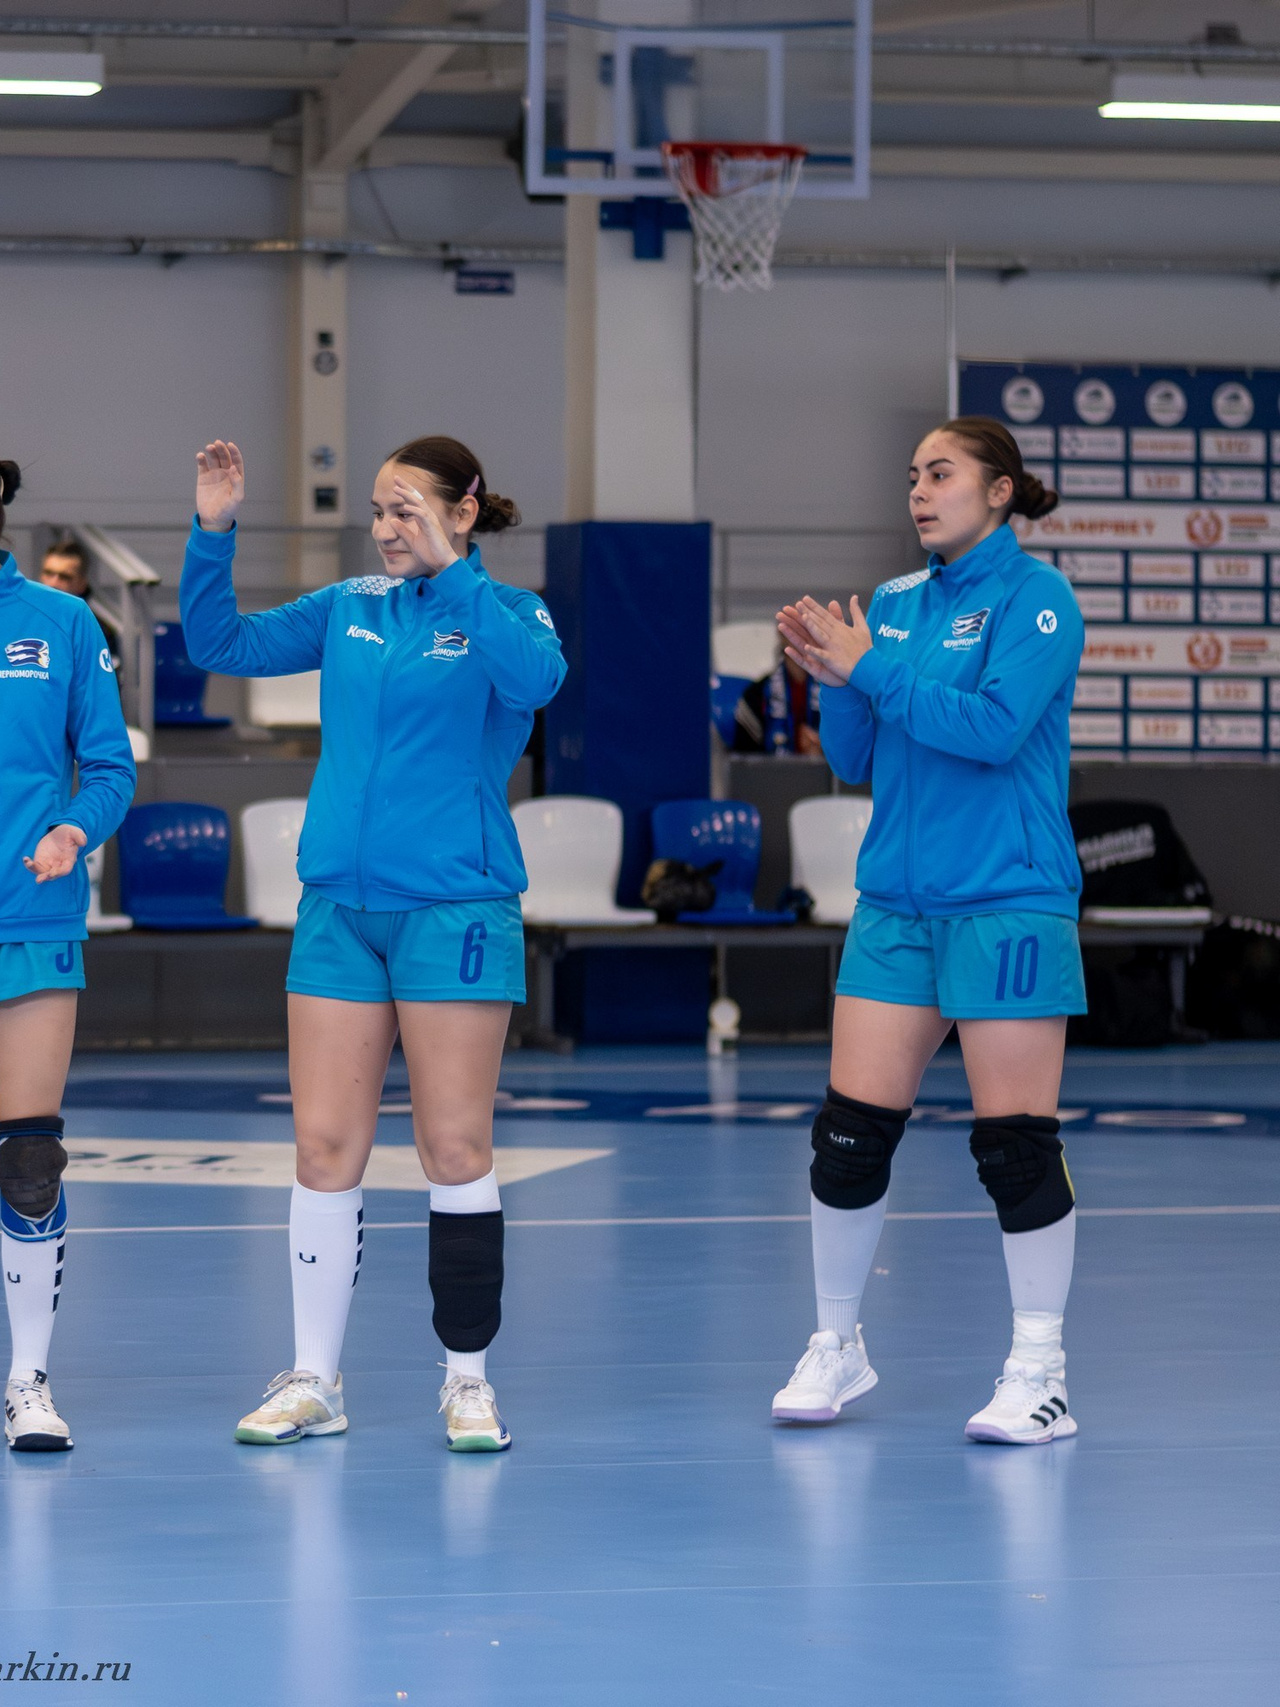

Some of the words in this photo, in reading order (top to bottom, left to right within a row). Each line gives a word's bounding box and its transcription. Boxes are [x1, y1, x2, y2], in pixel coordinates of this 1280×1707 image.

[346, 625, 385, 645] Kempa
[459, 921, 488, 985] 6
[994, 934, 1039, 1001] 10
